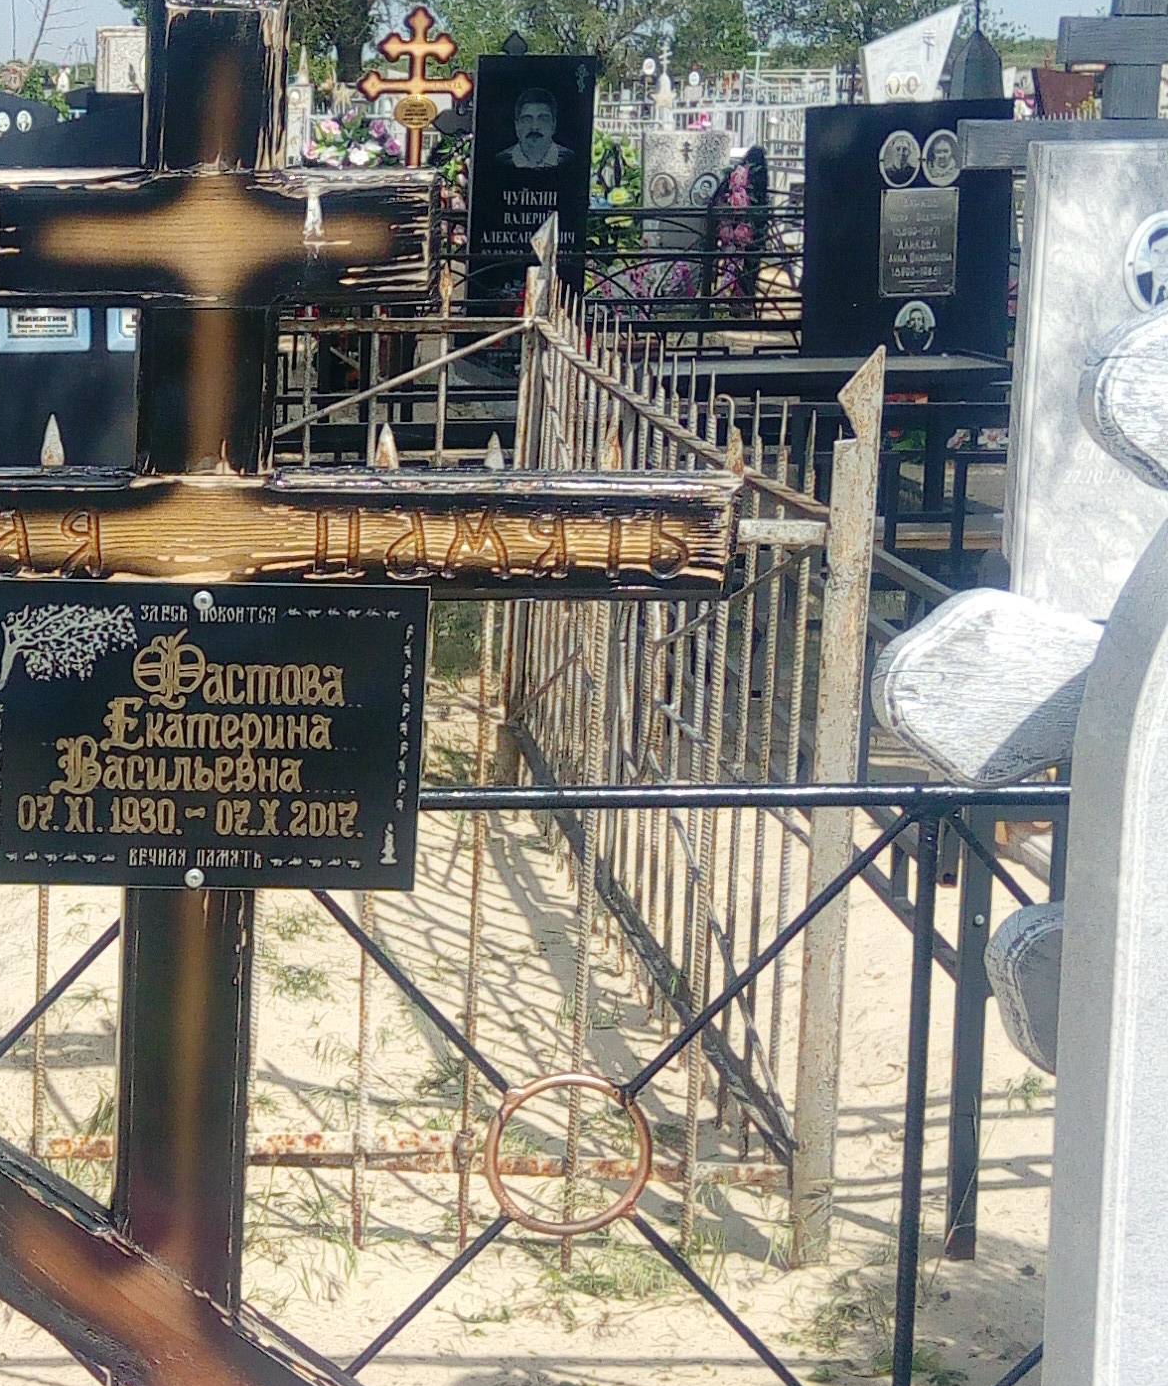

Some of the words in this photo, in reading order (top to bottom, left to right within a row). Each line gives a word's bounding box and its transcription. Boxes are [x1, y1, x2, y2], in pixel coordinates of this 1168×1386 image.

[503, 187, 559, 206] ЧУЙКИН
[310, 506, 692, 579] ПАМЯТЬ
[140, 604, 188, 623] ЗДЕСЬ
[199, 605, 277, 624] ПОКОИТСЯ
[132, 628, 346, 709] Фастова
[100, 697, 333, 756] Екатерина
[48, 734, 303, 795] Васильевна
[128, 847, 187, 867] ВЕЧНАЯ
[195, 848, 262, 869] ПАМЯТЬ
